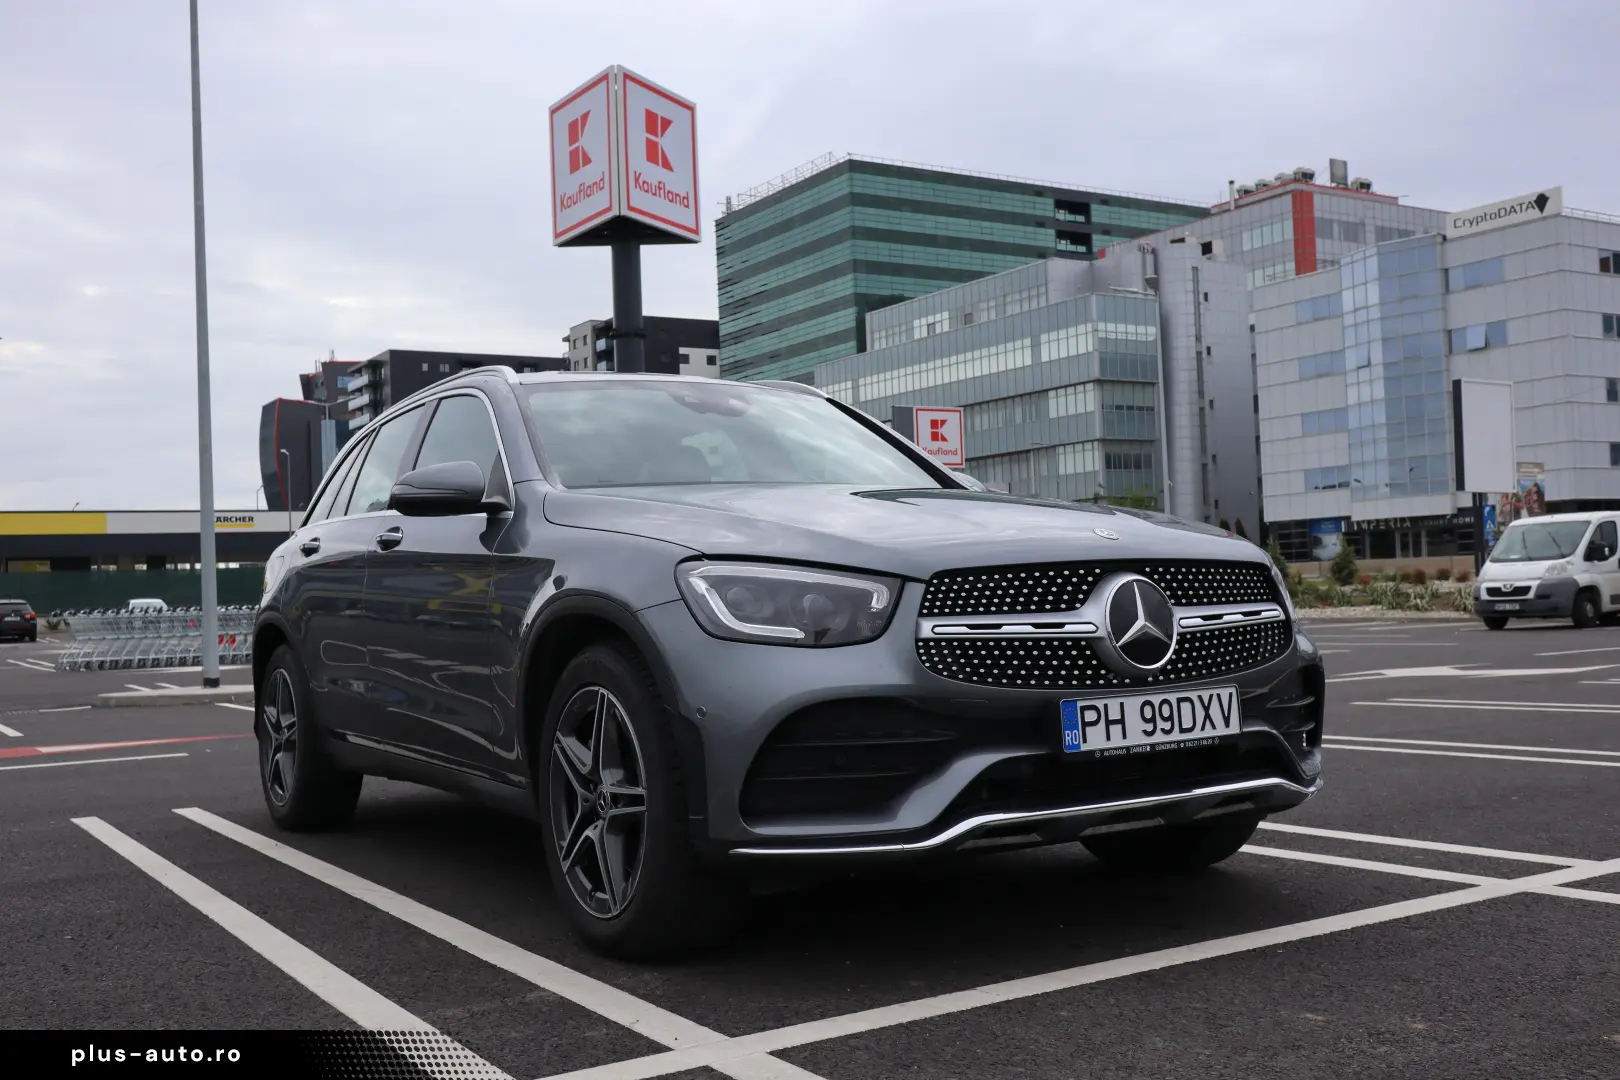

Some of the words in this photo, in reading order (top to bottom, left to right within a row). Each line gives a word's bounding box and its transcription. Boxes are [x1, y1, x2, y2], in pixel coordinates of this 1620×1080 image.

[560, 171, 605, 212] Kaufland
[634, 170, 690, 209] Kaufland
[1453, 201, 1536, 228] CryptoDATA
[1079, 702, 1128, 744] PH
[1140, 692, 1233, 737] 99DXV
[1065, 730, 1080, 746] RO
